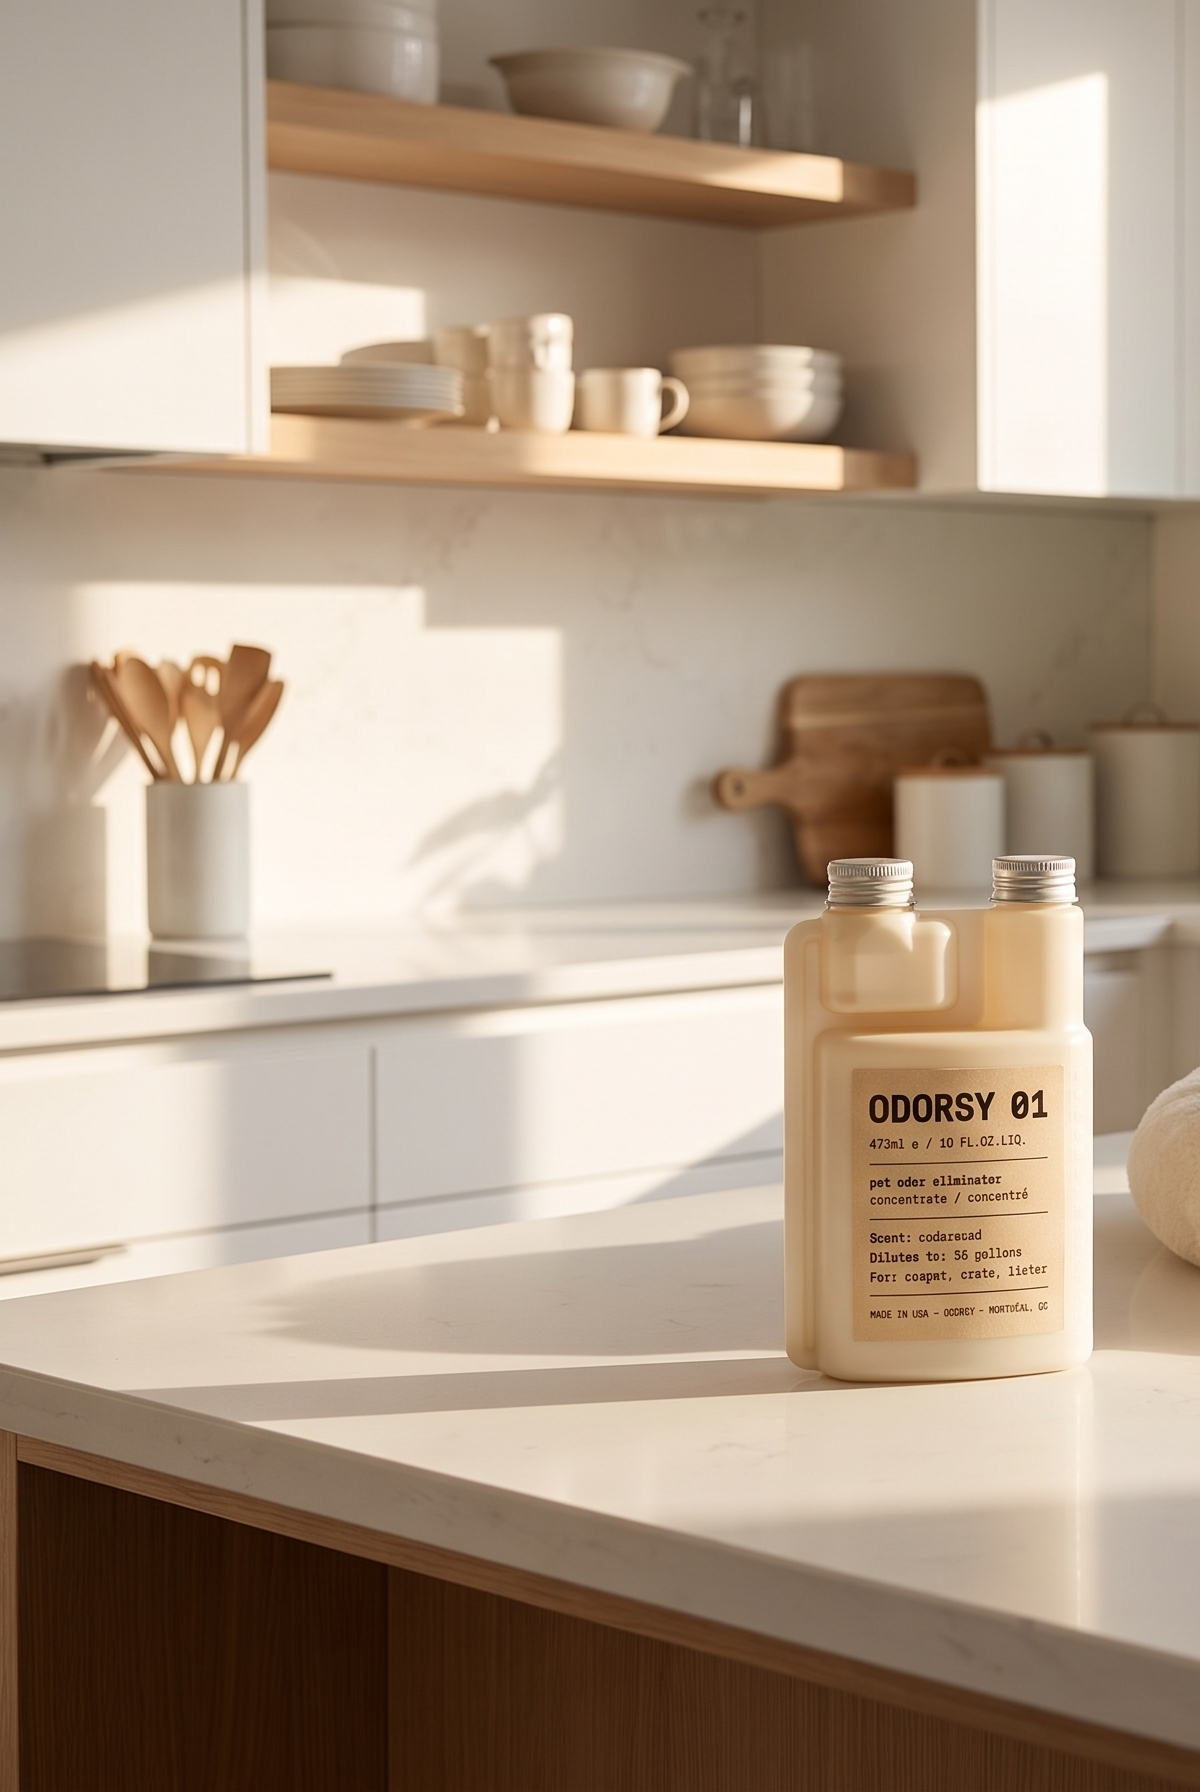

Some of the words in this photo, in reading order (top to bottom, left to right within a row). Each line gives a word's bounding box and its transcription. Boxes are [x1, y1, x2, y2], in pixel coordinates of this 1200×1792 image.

[869, 1092, 995, 1123] ODORSY
[1011, 1090, 1048, 1119] 01
[869, 1138, 905, 1150] 473ml
[912, 1141, 919, 1150] e
[926, 1137, 932, 1150] /
[940, 1137, 954, 1149] 10
[869, 1177, 891, 1191] pet
[870, 1194, 947, 1205] concentrate
[954, 1192, 961, 1205] /
[967, 1187, 1029, 1203] concentré
[869, 1232, 911, 1244] Scent:
[869, 1252, 919, 1263] Dilutes
[926, 1251, 946, 1262] to:
[960, 1267, 1000, 1280] crate,
[870, 1310, 892, 1319] MADE
[897, 1310, 908, 1318] IN
[912, 1309, 929, 1318] USA
